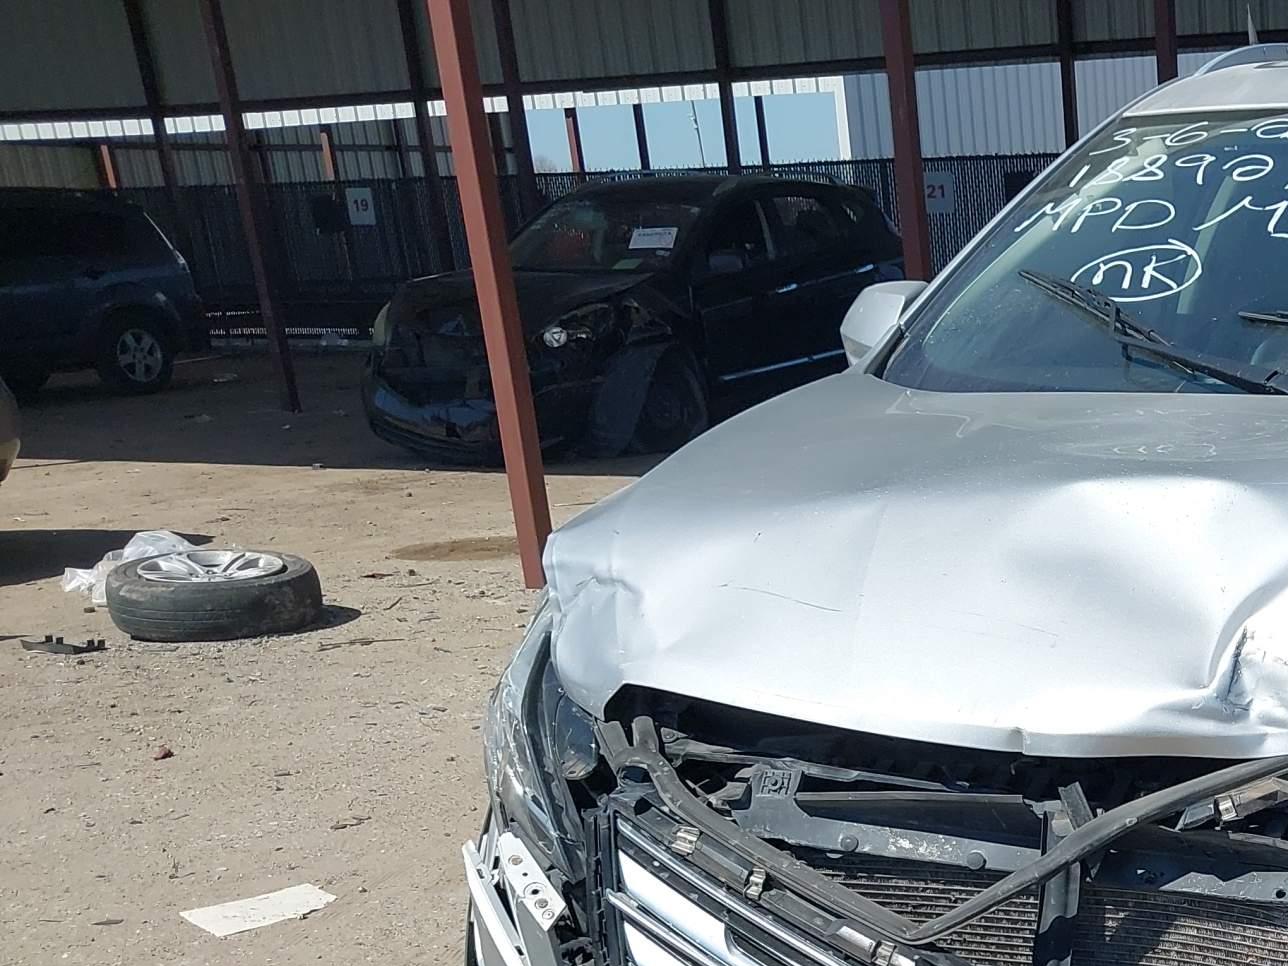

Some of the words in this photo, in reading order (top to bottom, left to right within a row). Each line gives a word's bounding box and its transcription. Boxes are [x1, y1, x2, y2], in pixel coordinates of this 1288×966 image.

[926, 184, 945, 199] 21
[353, 199, 369, 212] 19
[1014, 197, 1177, 233] MPD
